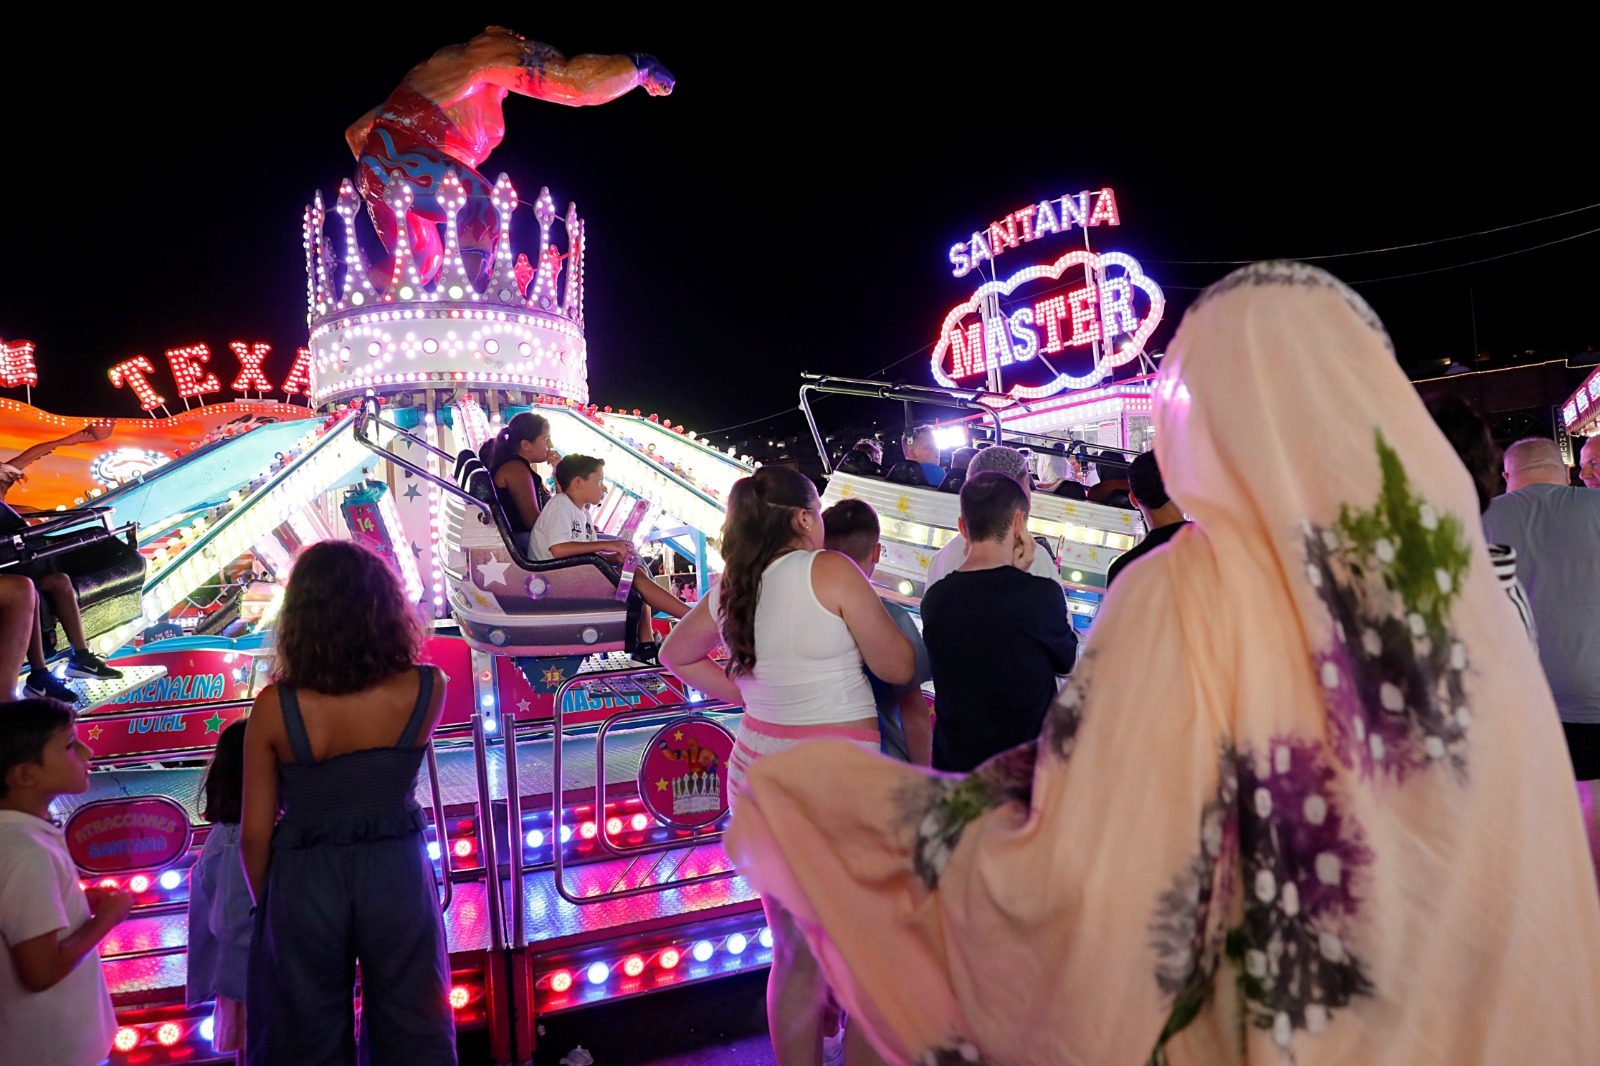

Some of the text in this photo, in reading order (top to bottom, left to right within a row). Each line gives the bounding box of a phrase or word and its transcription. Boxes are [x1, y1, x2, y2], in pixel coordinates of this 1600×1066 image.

[949, 187, 1120, 278] SANTANA
[950, 277, 1138, 379] MASTER
[356, 517, 375, 533] 14
